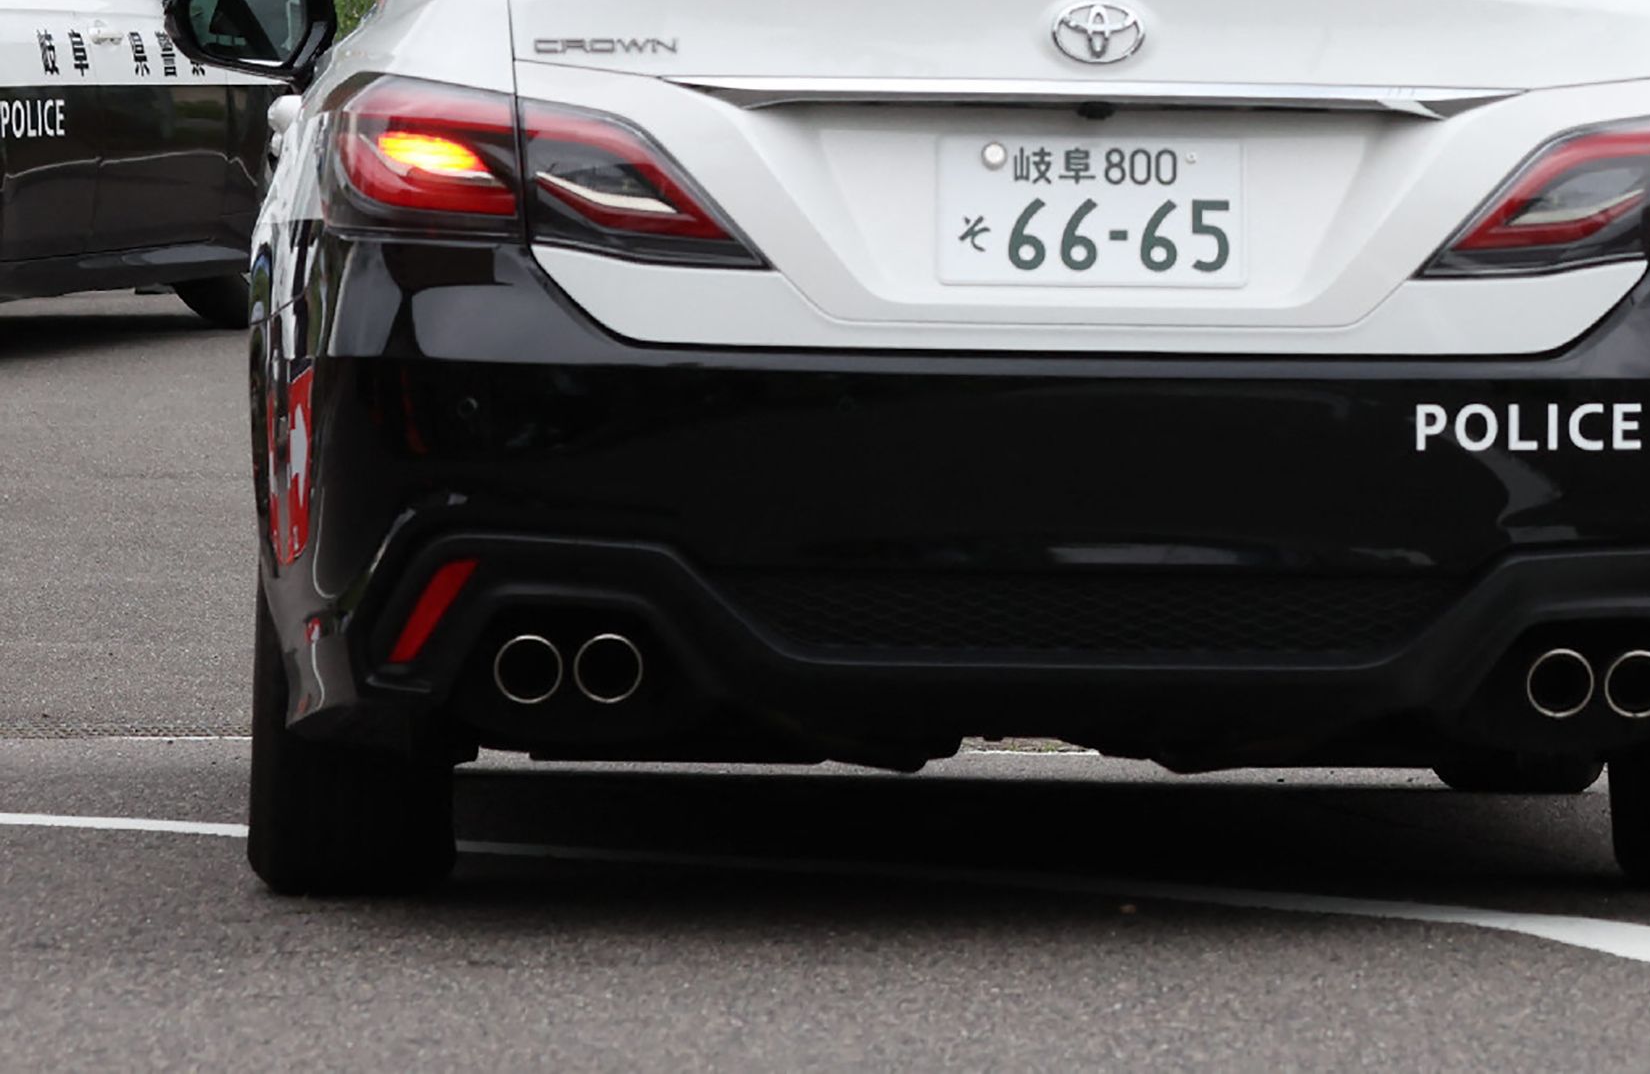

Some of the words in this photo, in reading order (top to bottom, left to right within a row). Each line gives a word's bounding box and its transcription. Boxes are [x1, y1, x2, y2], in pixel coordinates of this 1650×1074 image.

[534, 38, 679, 54] CROWN
[0, 99, 66, 139] POLICE
[1012, 147, 1096, 185] 岐阜
[1104, 148, 1178, 186] 800
[957, 215, 991, 253] そ
[1008, 198, 1231, 273] 66-65
[1415, 403, 1643, 452] POLICE
